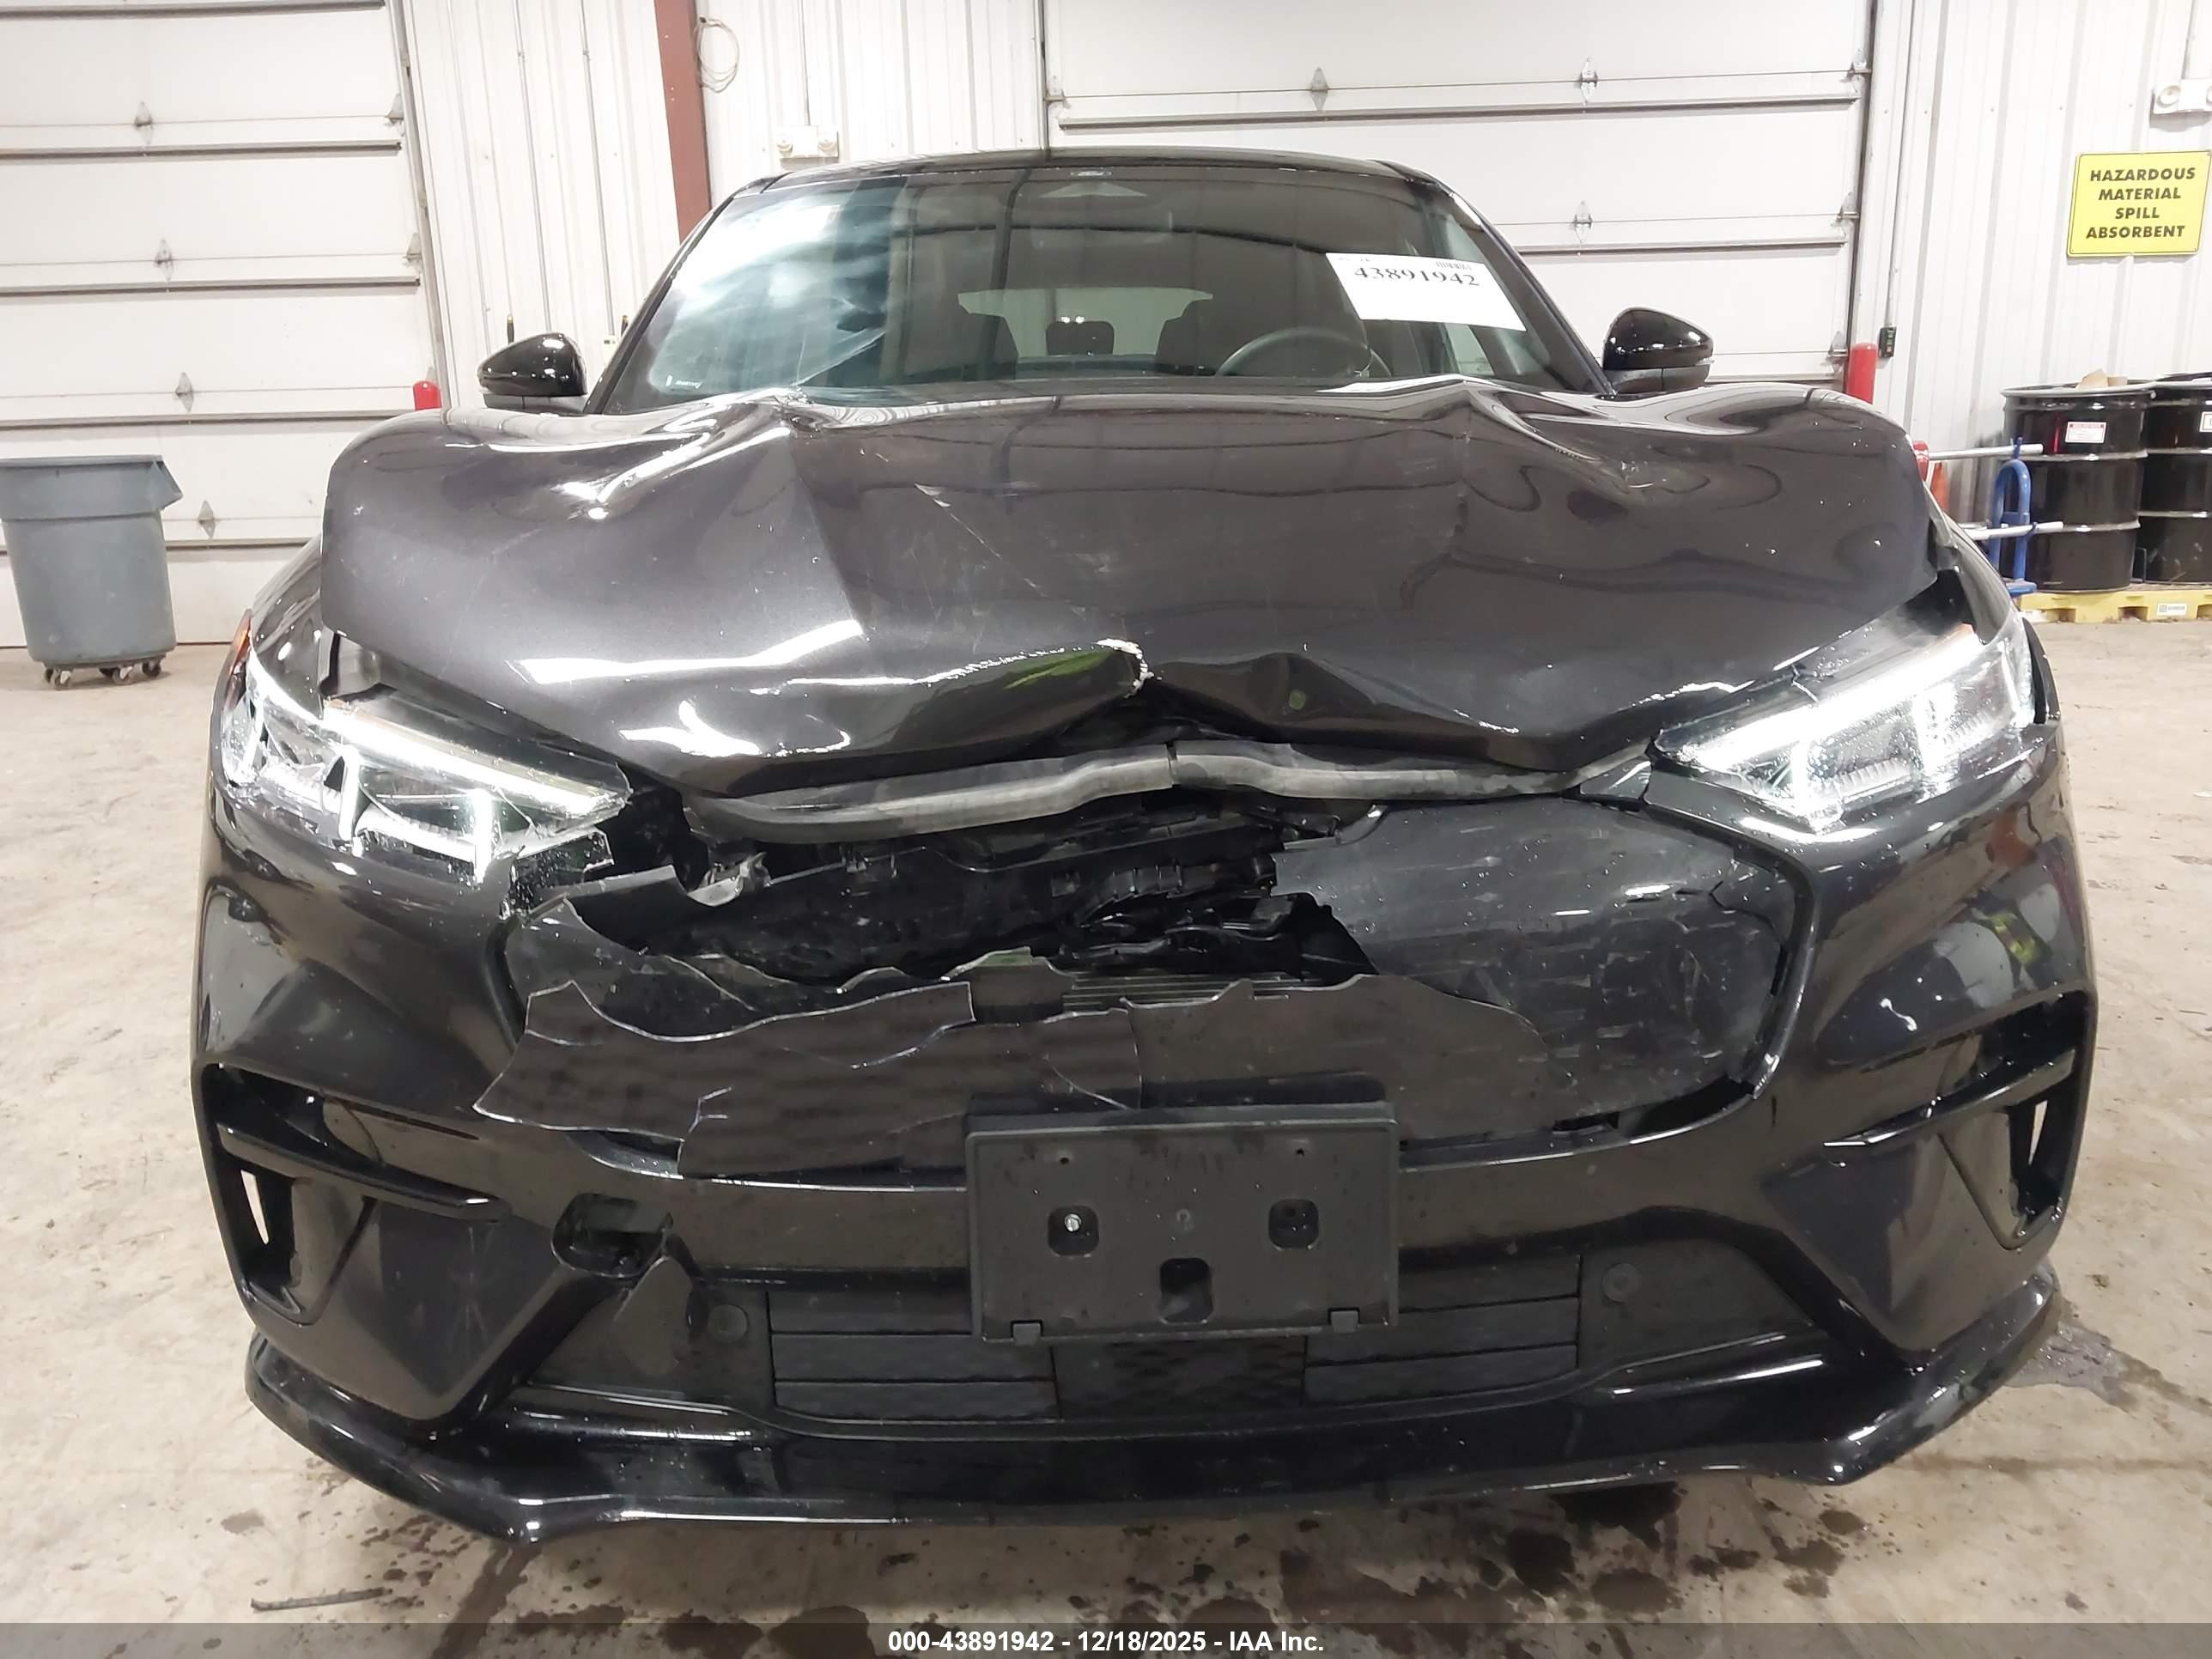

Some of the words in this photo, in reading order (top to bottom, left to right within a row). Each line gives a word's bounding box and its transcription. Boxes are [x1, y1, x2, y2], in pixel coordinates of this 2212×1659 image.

[2089, 167, 2196, 181] HAZARDOUS
[2098, 187, 2181, 200] MATERIAL
[2114, 207, 2160, 219] SPILL
[2086, 225, 2185, 239] ABSORBENT
[1354, 267, 1480, 286] 43891942
